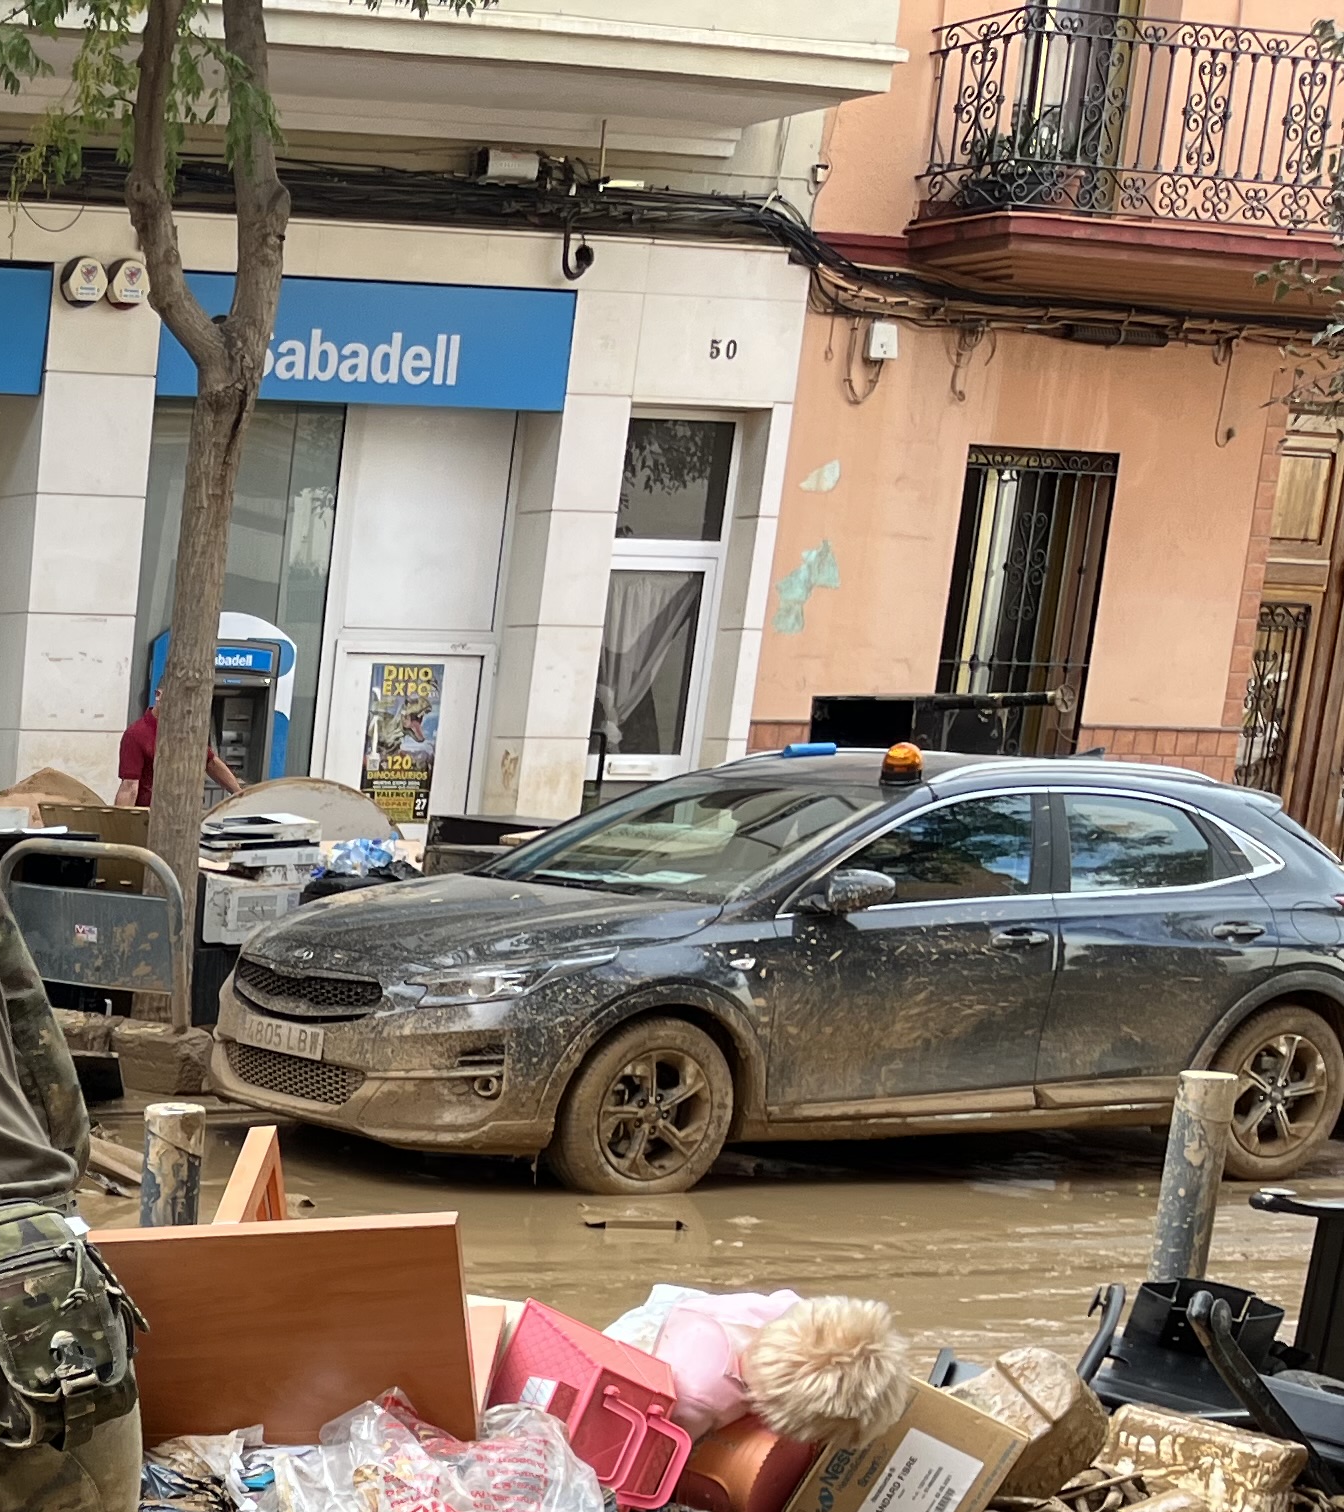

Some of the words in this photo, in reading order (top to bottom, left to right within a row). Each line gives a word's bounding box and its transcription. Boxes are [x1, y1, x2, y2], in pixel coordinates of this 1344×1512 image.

[263, 328, 460, 385] abadell
[709, 339, 737, 360] 50
[215, 654, 253, 666] badell
[384, 665, 433, 680] DINO
[382, 680, 431, 697] EXPO
[386, 755, 412, 770] 120
[367, 771, 428, 780] DINOSAURIOS
[415, 798, 427, 810] 27
[897, 1455, 917, 1482] FIBRE
